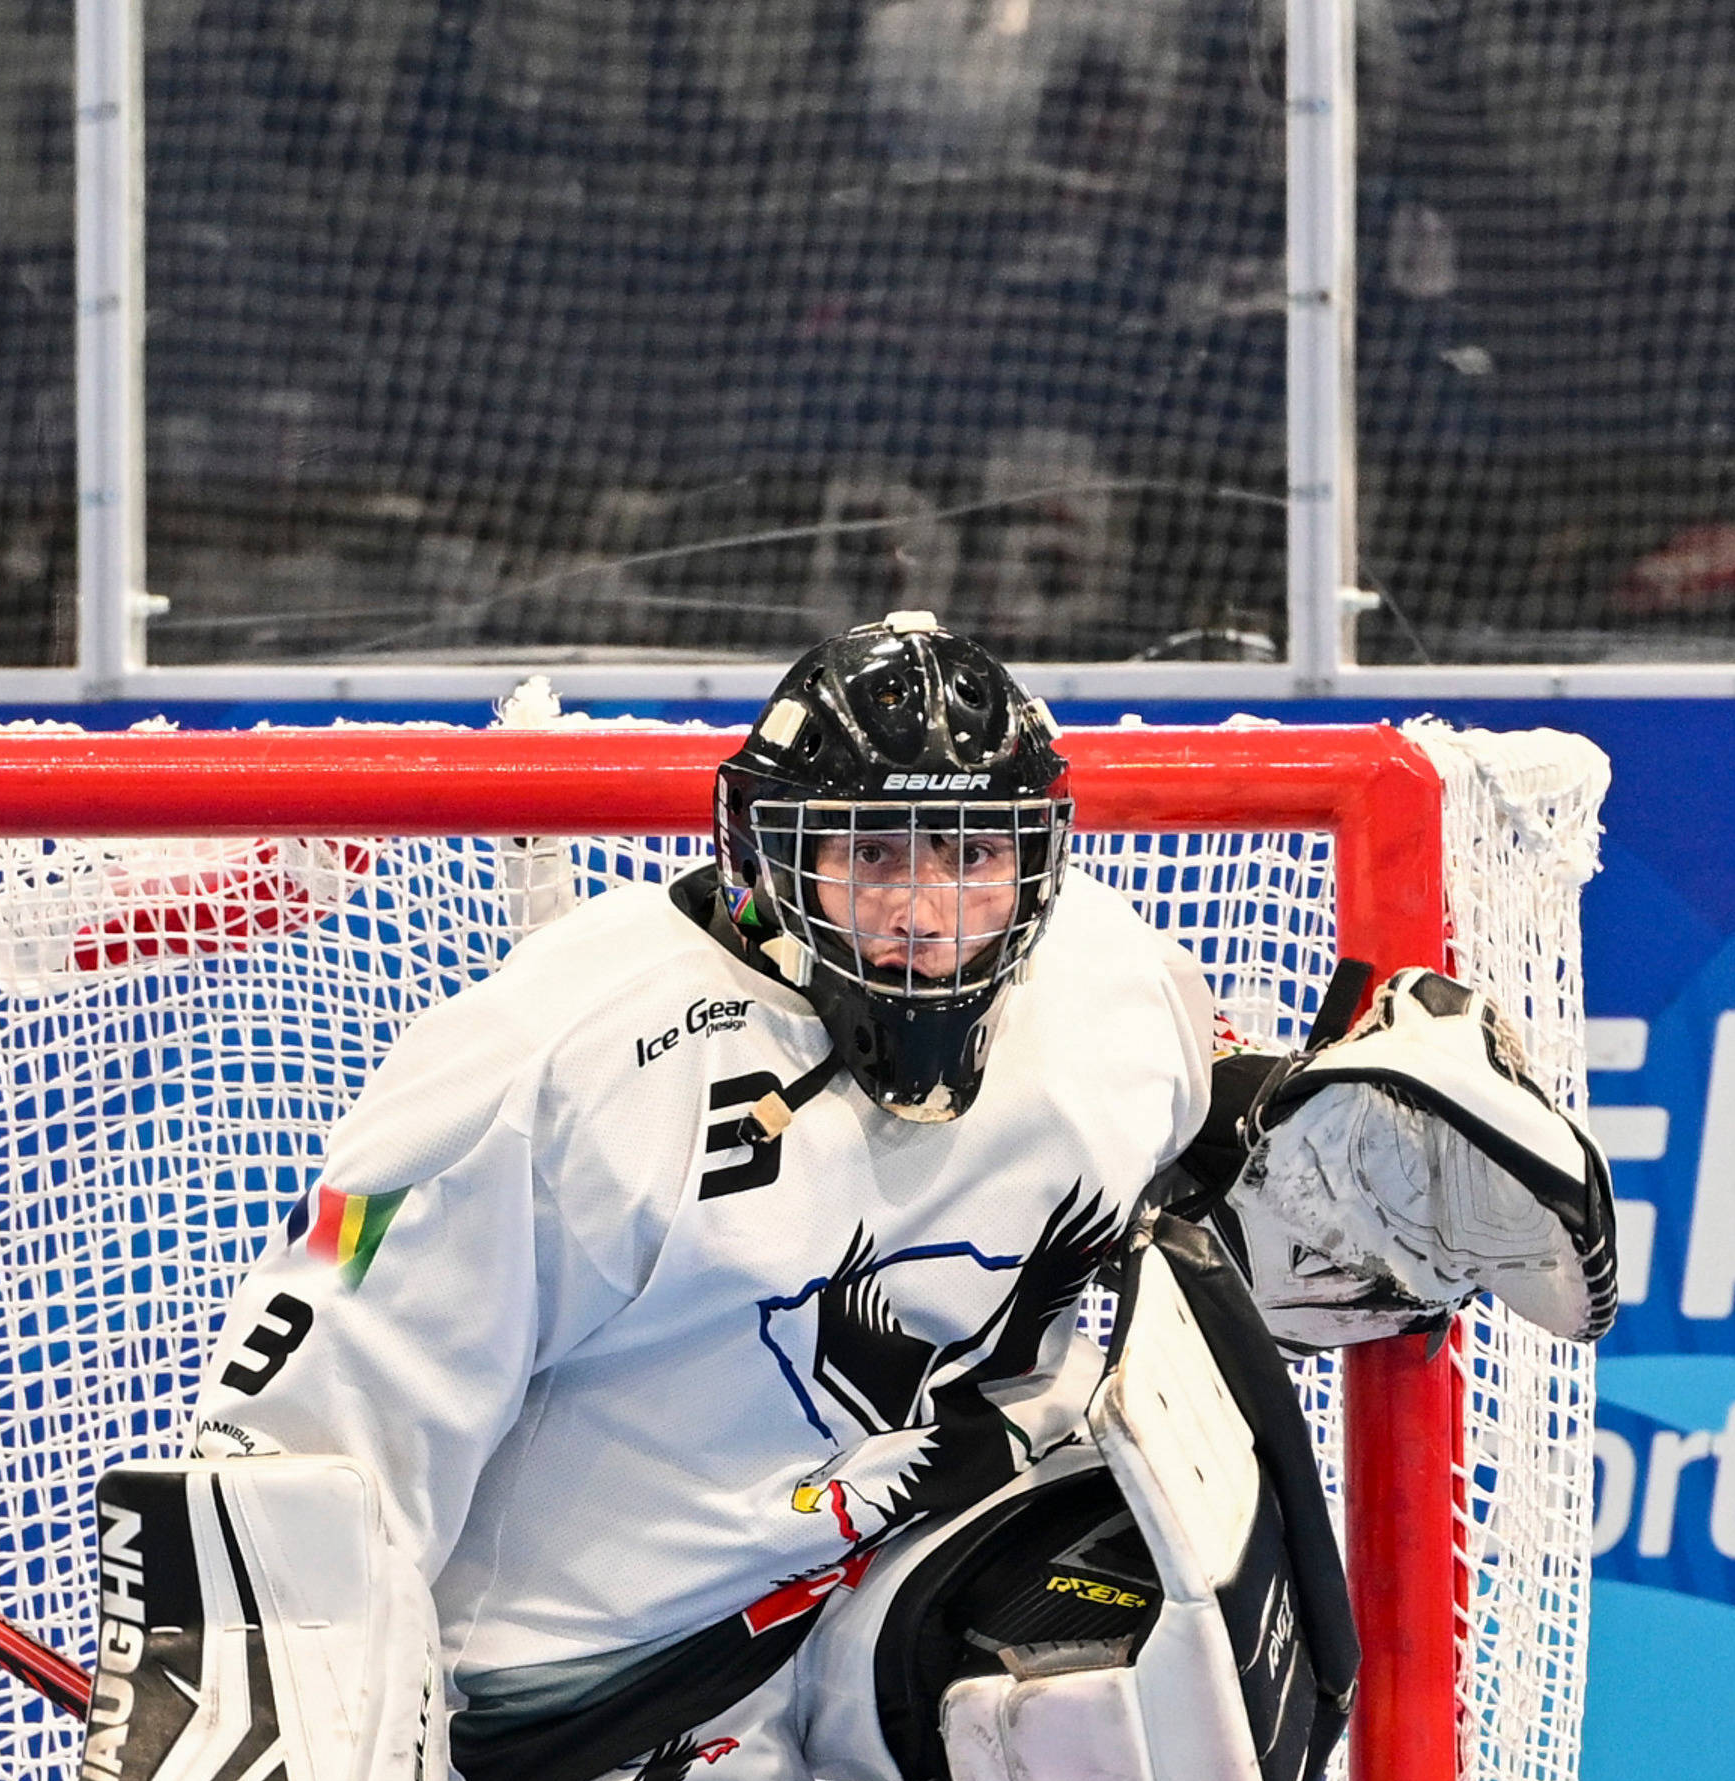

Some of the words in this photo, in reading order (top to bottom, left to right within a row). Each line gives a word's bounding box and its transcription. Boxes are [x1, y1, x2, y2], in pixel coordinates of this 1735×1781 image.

[882, 773, 992, 791] BAUER
[636, 1027, 680, 1068] Ice
[685, 998, 756, 1035] Gear
[705, 1017, 748, 1039] Design
[219, 1292, 315, 1397] 3
